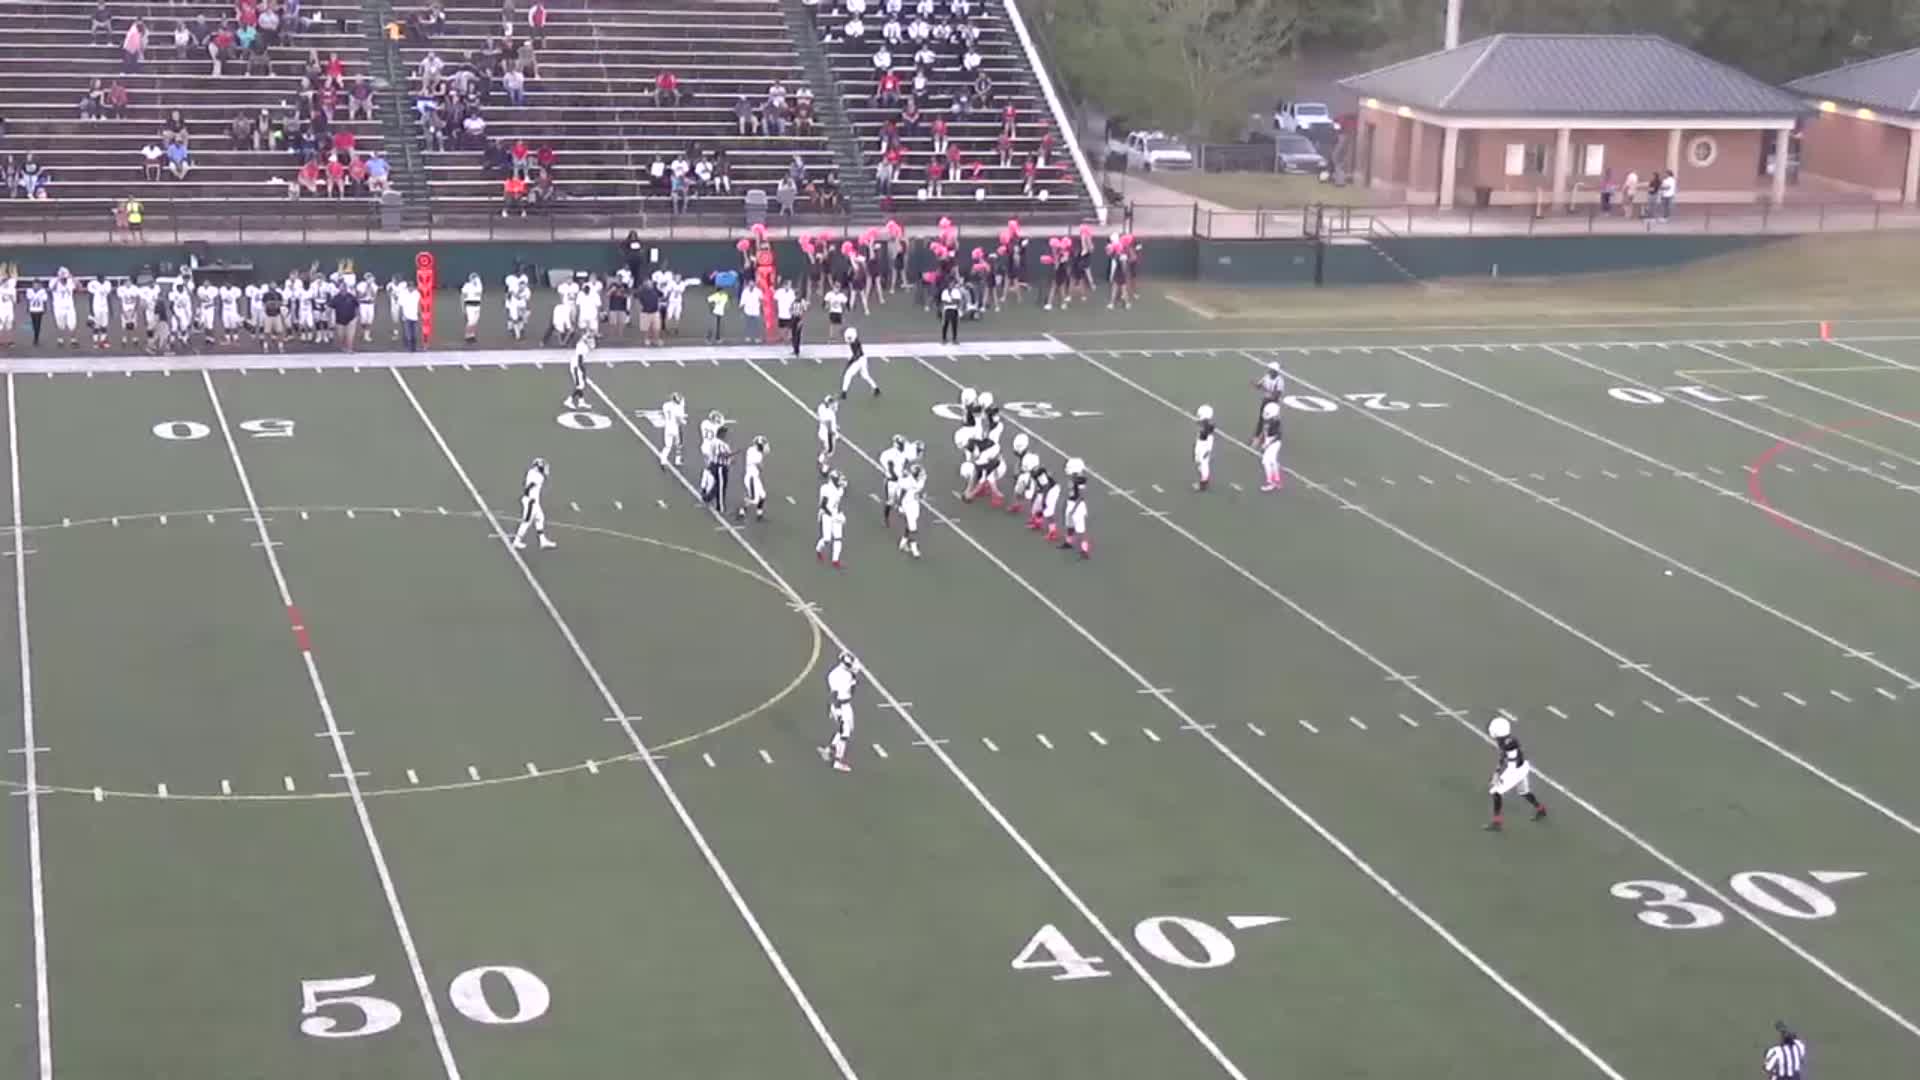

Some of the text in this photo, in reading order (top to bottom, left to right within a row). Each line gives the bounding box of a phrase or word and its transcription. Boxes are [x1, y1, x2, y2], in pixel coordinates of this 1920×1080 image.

[1610, 871, 1837, 930] 30
[1011, 915, 1236, 980] 40
[301, 965, 550, 1037] 50
